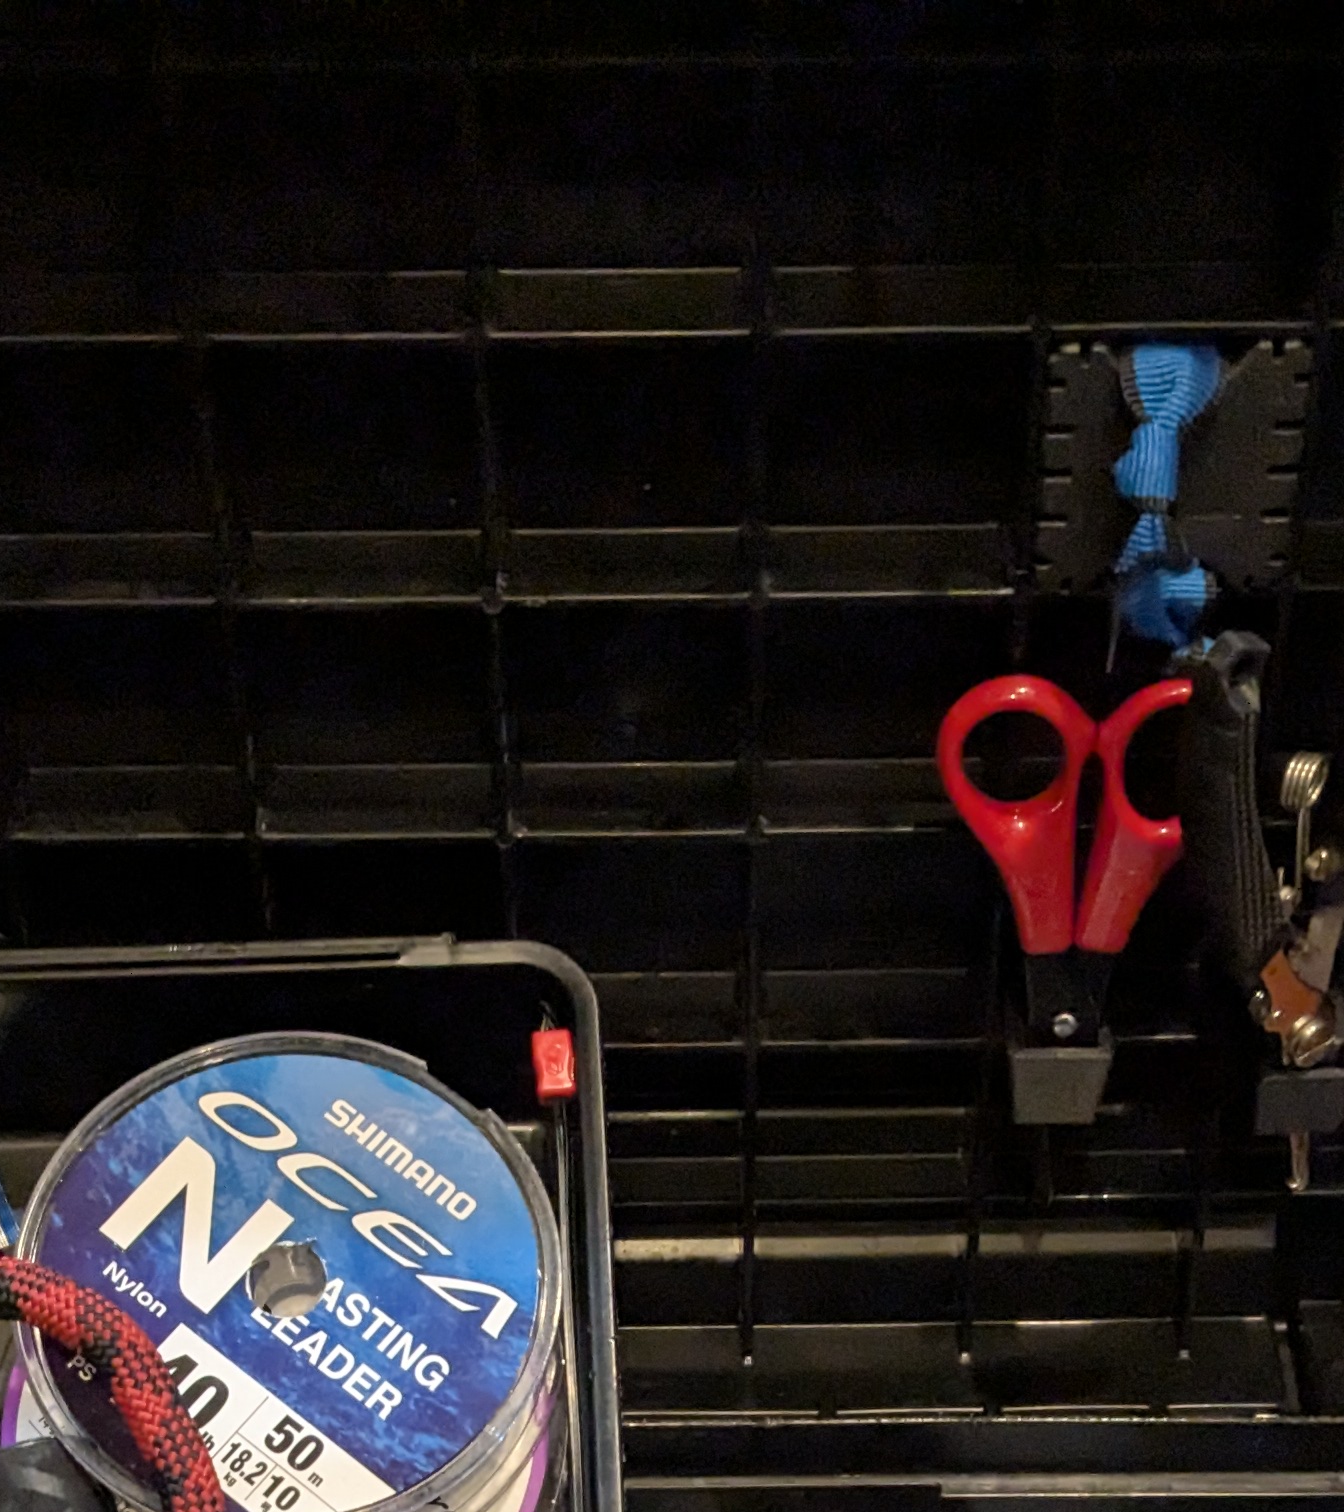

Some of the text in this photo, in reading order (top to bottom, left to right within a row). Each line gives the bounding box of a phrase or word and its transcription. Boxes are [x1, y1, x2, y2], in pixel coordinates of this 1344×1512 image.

[323, 1098, 478, 1222] SHIMANO
[98, 1135, 296, 1315] N
[197, 1091, 519, 1341] OCEA
[102, 1260, 168, 1319] Nylon
[318, 1276, 451, 1393] ASTING
[220, 1441, 268, 1488] 18.2 kg
[261, 1473, 301, 1512] 10
[263, 1413, 325, 1488] 50 m
